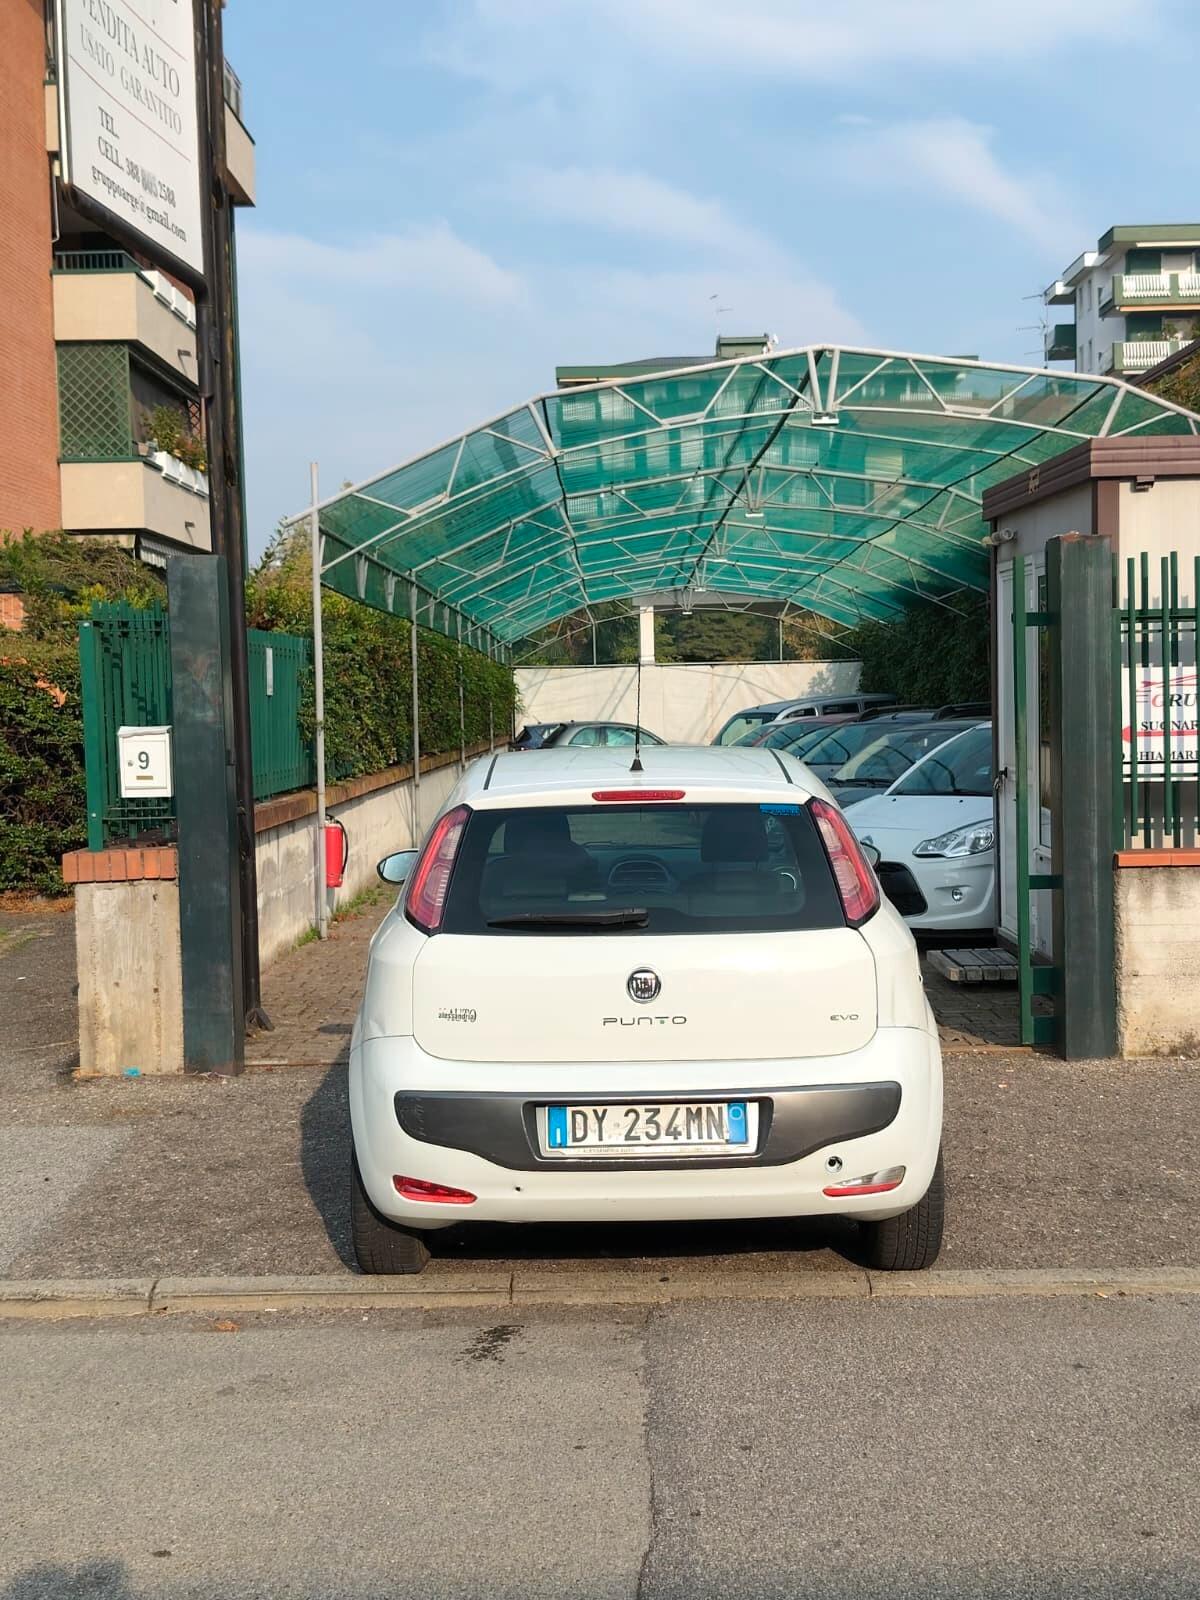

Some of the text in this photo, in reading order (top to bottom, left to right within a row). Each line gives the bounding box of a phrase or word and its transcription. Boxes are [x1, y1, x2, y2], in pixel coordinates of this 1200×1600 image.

[80, 23, 182, 135] USATO GARANTITO
[142, 44, 180, 97] AUTO
[138, 751, 150, 770] 9
[602, 1016, 687, 1026] PUNTO
[571, 1108, 608, 1143] DY
[623, 1106, 724, 1142] 234MN
